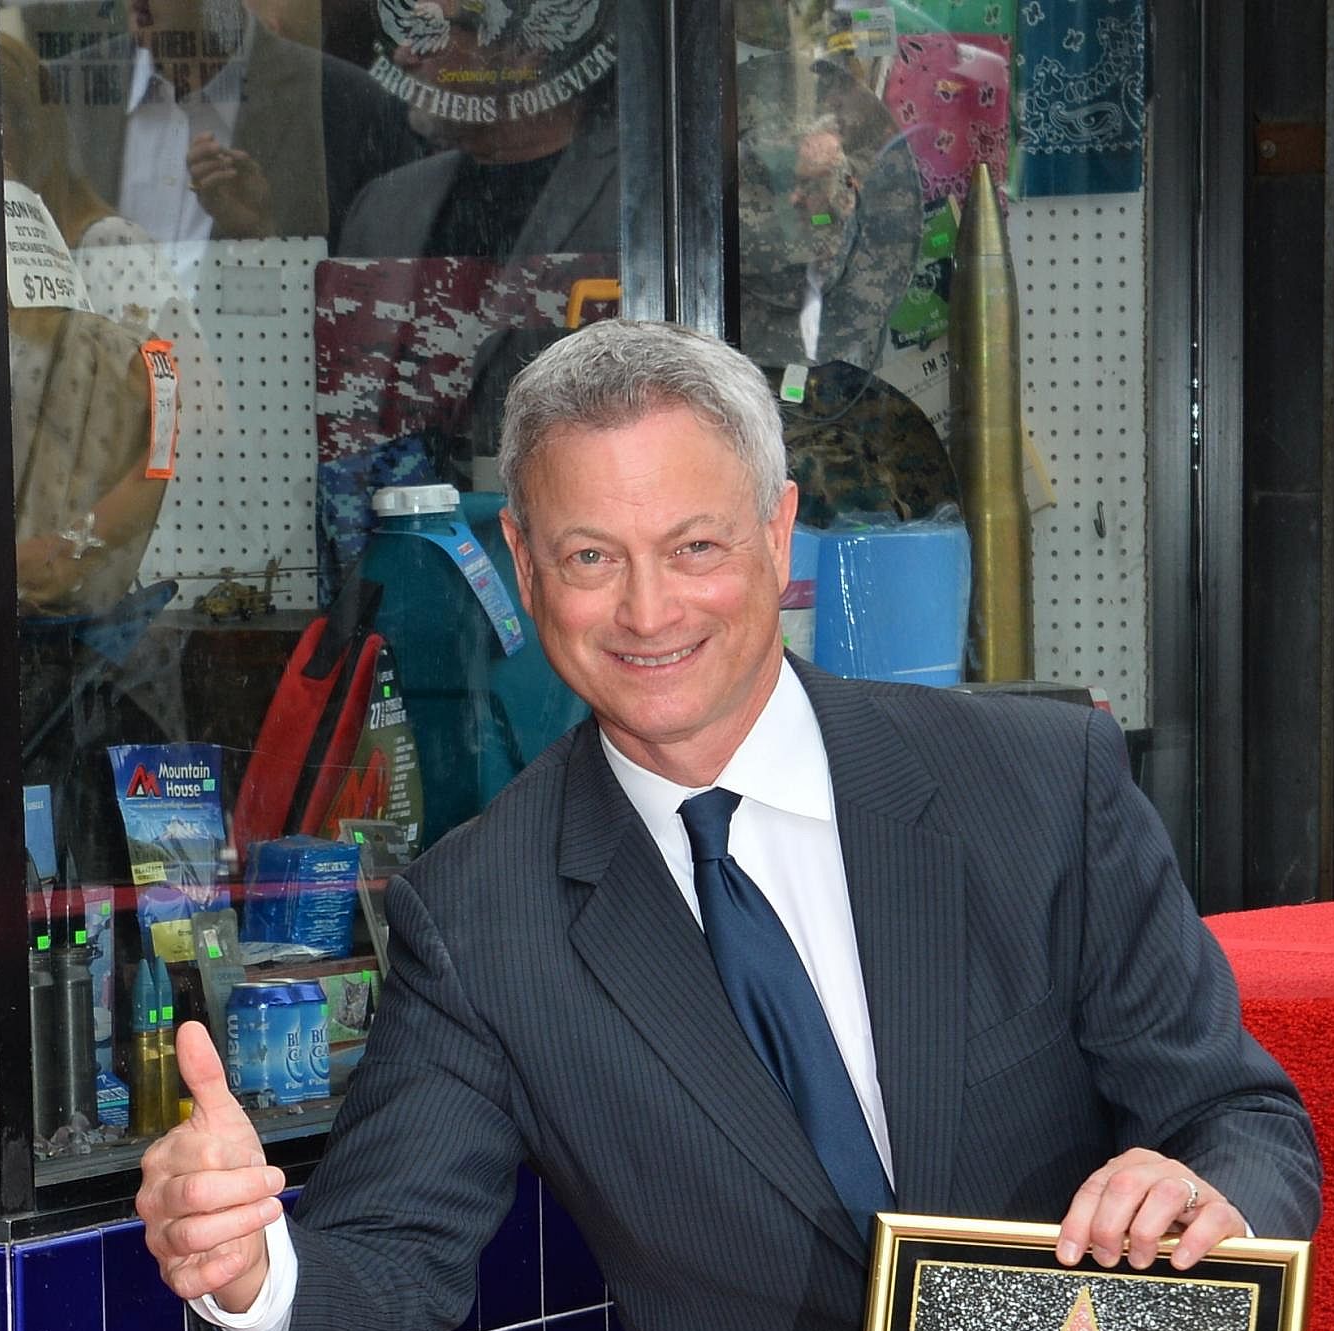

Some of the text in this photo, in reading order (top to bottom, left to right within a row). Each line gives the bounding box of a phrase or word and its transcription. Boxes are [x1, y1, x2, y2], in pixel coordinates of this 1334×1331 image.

[922, 359, 939, 377] FM
[158, 760, 211, 780] Mountain
[166, 782, 202, 798] House
